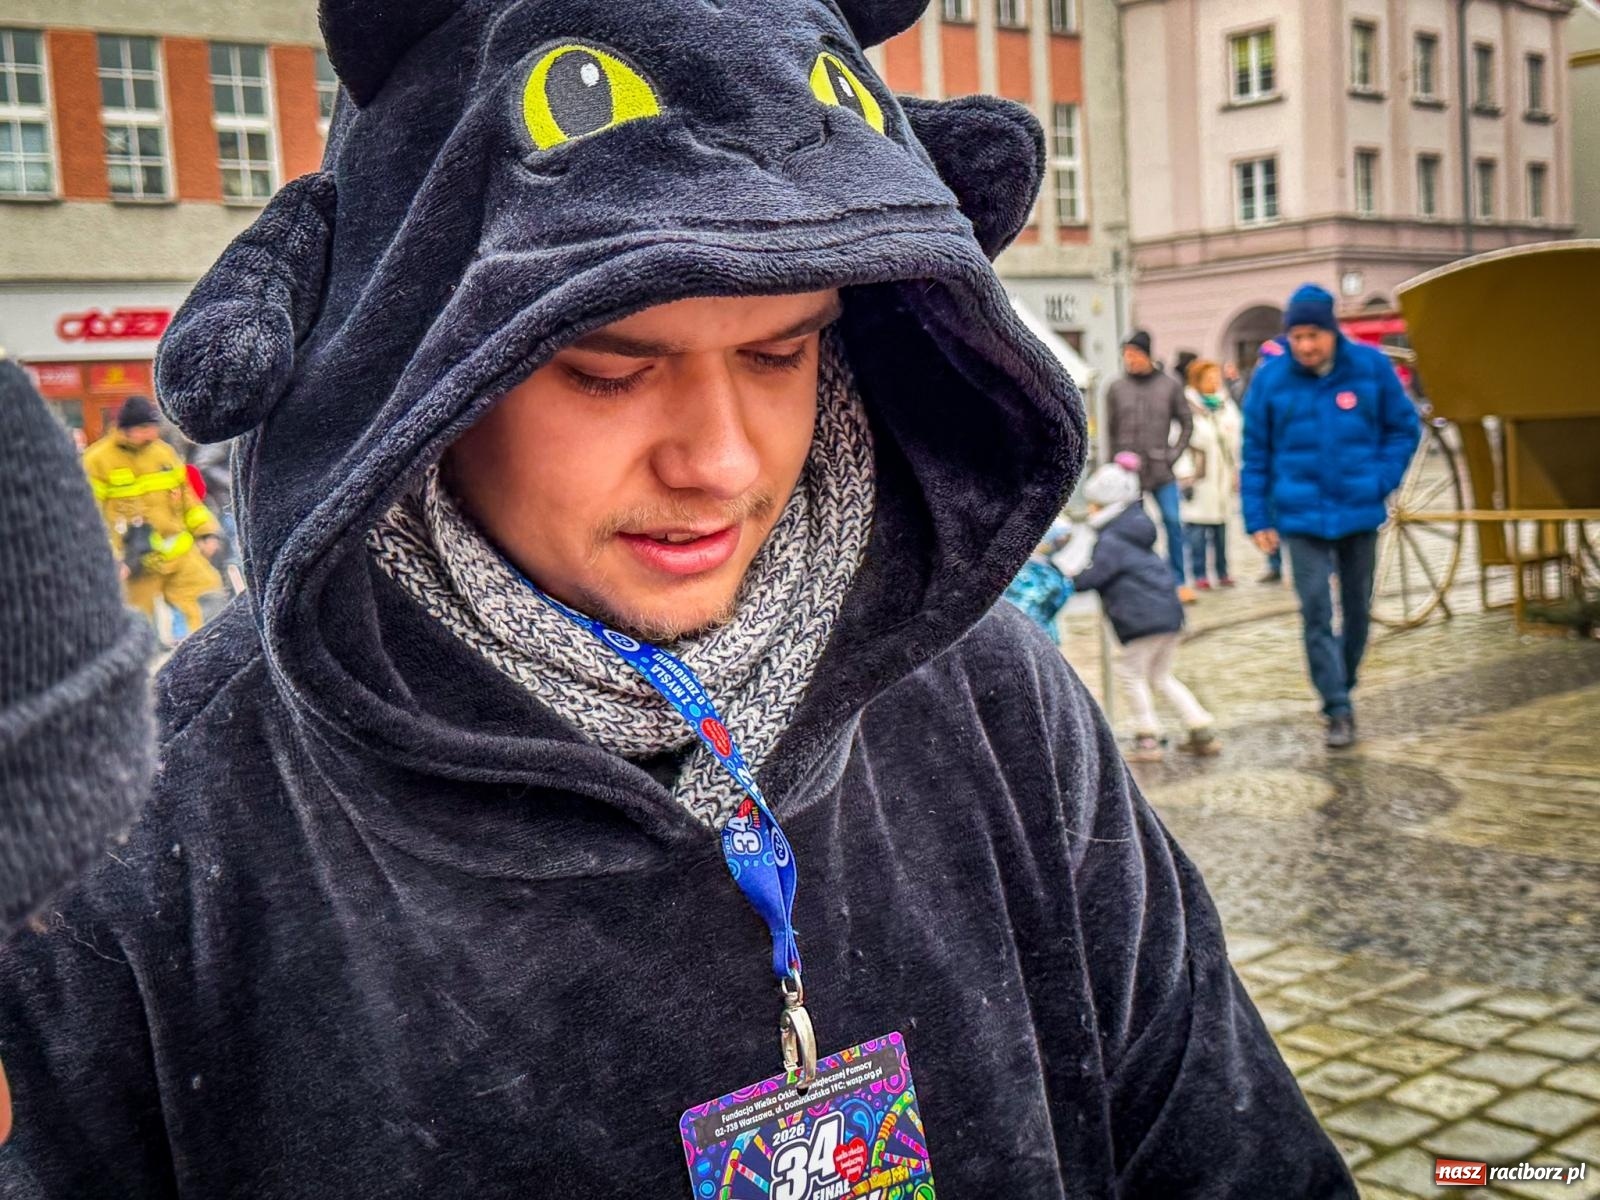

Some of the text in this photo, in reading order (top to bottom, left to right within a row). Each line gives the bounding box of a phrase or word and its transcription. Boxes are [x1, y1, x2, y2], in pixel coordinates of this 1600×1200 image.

[650, 663, 692, 705] Z MYŚLĄ
[652, 653, 706, 705] O ZDROWIU
[727, 815, 761, 854] 34
[714, 1121, 739, 1137] 02-738
[739, 1110, 775, 1128] Warszawa,
[775, 1104, 784, 1114] ul.
[846, 1067, 883, 1087] wosp.org.pl
[721, 1105, 754, 1123] Fundacja
[753, 1097, 777, 1111] Wielka
[777, 1088, 798, 1101] Orkie
[846, 1061, 872, 1077] Pomocy
[772, 1122, 806, 1146] 2026
[774, 1116, 840, 1200] 34
[813, 1179, 850, 1200] FINAL
